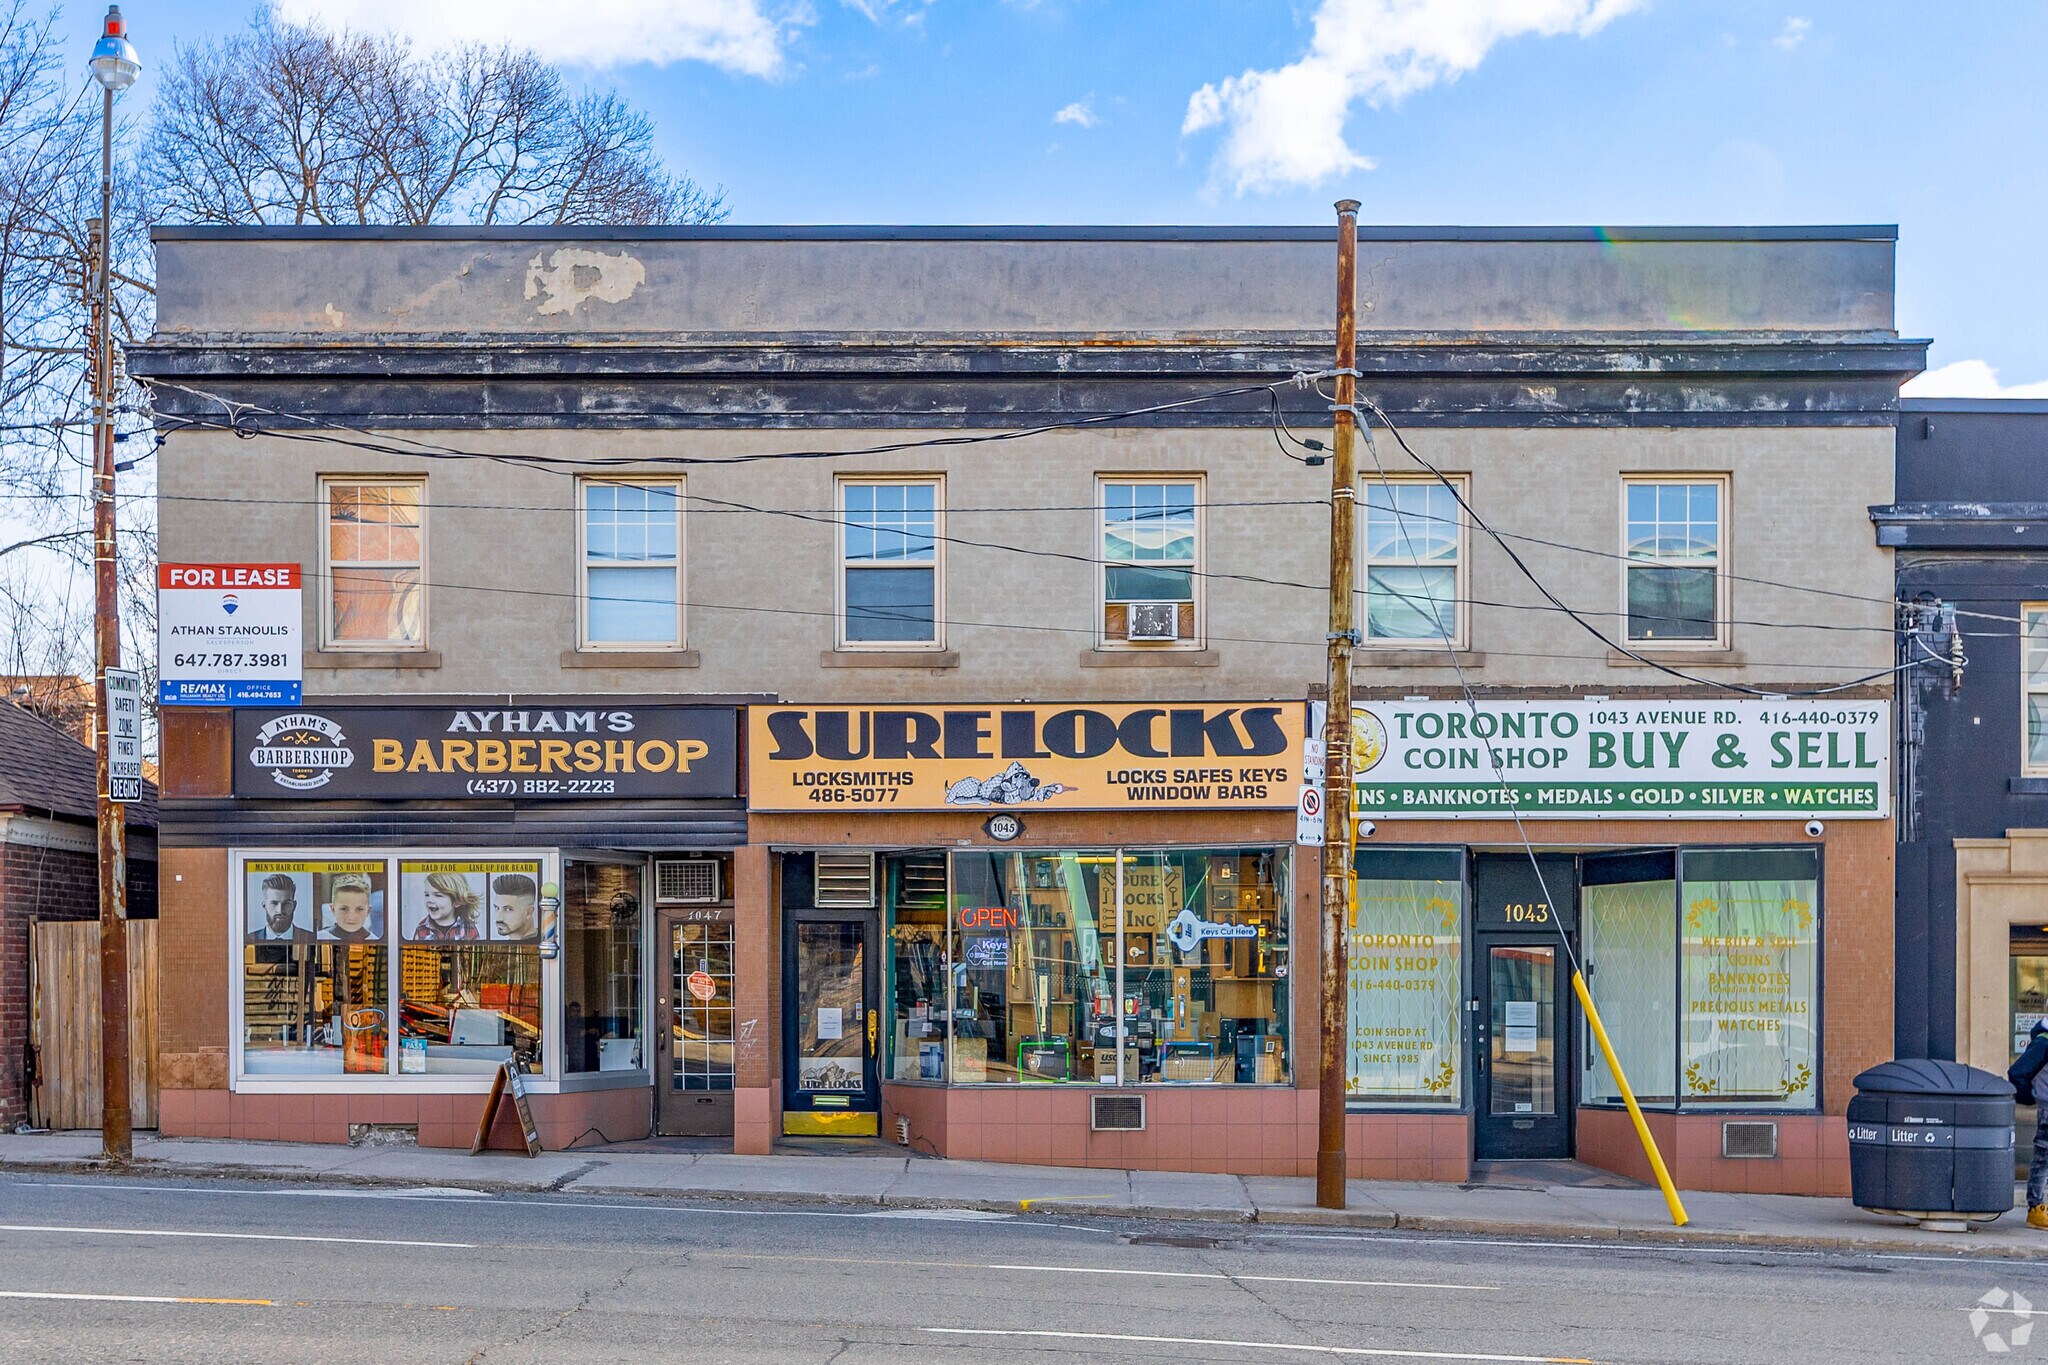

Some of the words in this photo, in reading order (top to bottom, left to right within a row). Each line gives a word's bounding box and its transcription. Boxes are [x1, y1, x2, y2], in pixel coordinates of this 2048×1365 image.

[170, 569, 215, 586] FOR
[222, 569, 290, 586] LEASE
[171, 626, 214, 635] ATHAN
[218, 626, 288, 635] STANOULIS
[174, 654, 287, 667] 647.787.3981
[108, 675, 138, 693] COMMUNITY
[180, 684, 225, 693] RE/MAX
[115, 697, 135, 713] SAFETY
[275, 716, 328, 732] AYHAM'S
[446, 711, 636, 733] AYHAM'S
[1588, 711, 1629, 725] 1043
[1635, 711, 1707, 724] AVENUE
[1713, 711, 1742, 724] RD.
[1759, 711, 1879, 725] 416-440-0379
[118, 718, 133, 733] ZONE
[1393, 712, 1579, 739] TORONTO
[118, 741, 134, 756] FINES
[1311, 743, 1319, 754] NO
[1588, 731, 1689, 769] BUY
[1711, 732, 1749, 769] &
[1770, 731, 1879, 769] SELL
[257, 749, 348, 765] BARBERSHOP
[371, 738, 710, 774] BARBERSHOP
[1304, 755, 1325, 768] STANDING
[1403, 747, 1479, 770] COIN
[1491, 747, 1569, 770] SHOP
[111, 761, 140, 776] INCREASED
[792, 771, 914, 786] LOCKSMITHS
[1107, 769, 1167, 785] LOCKS
[1173, 769, 1233, 783] SAFES
[1239, 768, 1288, 782] KEYS
[112, 779, 139, 798] BEGINS
[466, 779, 518, 795] (437)
[523, 779, 615, 794] 882-2223
[1127, 785, 1211, 801] WINDOW
[1217, 784, 1268, 799] BARS
[809, 788, 899, 803] 486-5077
[1354, 789, 1386, 805] INS
[1402, 788, 1520, 805] BANKNOTES
[1537, 788, 1613, 805] MEDALS
[1630, 788, 1685, 805] GOLD
[1701, 788, 1766, 805] SILVER
[1783, 788, 1874, 805] WATCHES
[993, 823, 1015, 833] 1045
[255, 863, 274, 871] MEN'S
[276, 863, 292, 871] HAIR
[293, 863, 305, 871] CUT
[327, 863, 344, 871] KIDS
[346, 863, 361, 871] HAIR
[363, 863, 376, 871] CUT
[421, 863, 438, 872] BALD
[440, 863, 457, 871] FADE
[469, 863, 483, 871] LINE
[485, 863, 495, 871] UP
[496, 864, 510, 872] FOR
[511, 864, 533, 872] BEARD
[688, 910, 721, 921] 1047
[961, 907, 1017, 928] OPEN
[1126, 910, 1156, 927] INC
[1504, 903, 1549, 923] 1043
[1201, 928, 1219, 938] Keys
[1220, 928, 1234, 936] Cut
[1235, 928, 1254, 936] Here
[982, 940, 1008, 950] Keys
[1353, 934, 1434, 949] TORONTO
[1701, 936, 1720, 947] WE
[1724, 936, 1751, 948] BUY
[1348, 956, 1390, 971] COIN
[1394, 956, 1439, 972] SHOP
[1728, 954, 1771, 967] COINS
[1350, 979, 1436, 991] 416-440-0379
[1708, 972, 1791, 985] BANKNOTES
[1692, 1000, 1755, 1013] PRECIOUS
[1759, 1001, 1807, 1013] METALS
[1357, 1027, 1383, 1037] COIN
[1385, 1027, 1412, 1037] SHOP
[1414, 1027, 1427, 1037] AT
[1717, 1019, 1781, 1032] WATCHES
[405, 1042, 423, 1050] PASS
[1351, 1040, 1374, 1050] 1043
[1377, 1041, 1417, 1050] AVENUE
[1419, 1041, 1433, 1051] RD
[1101, 1054, 1132, 1062] USCN
[1363, 1053, 1392, 1063] SINCE
[1396, 1054, 1420, 1064] 1985
[1856, 1126, 1878, 1140] Litter
[1891, 1129, 1919, 1143] Litter
